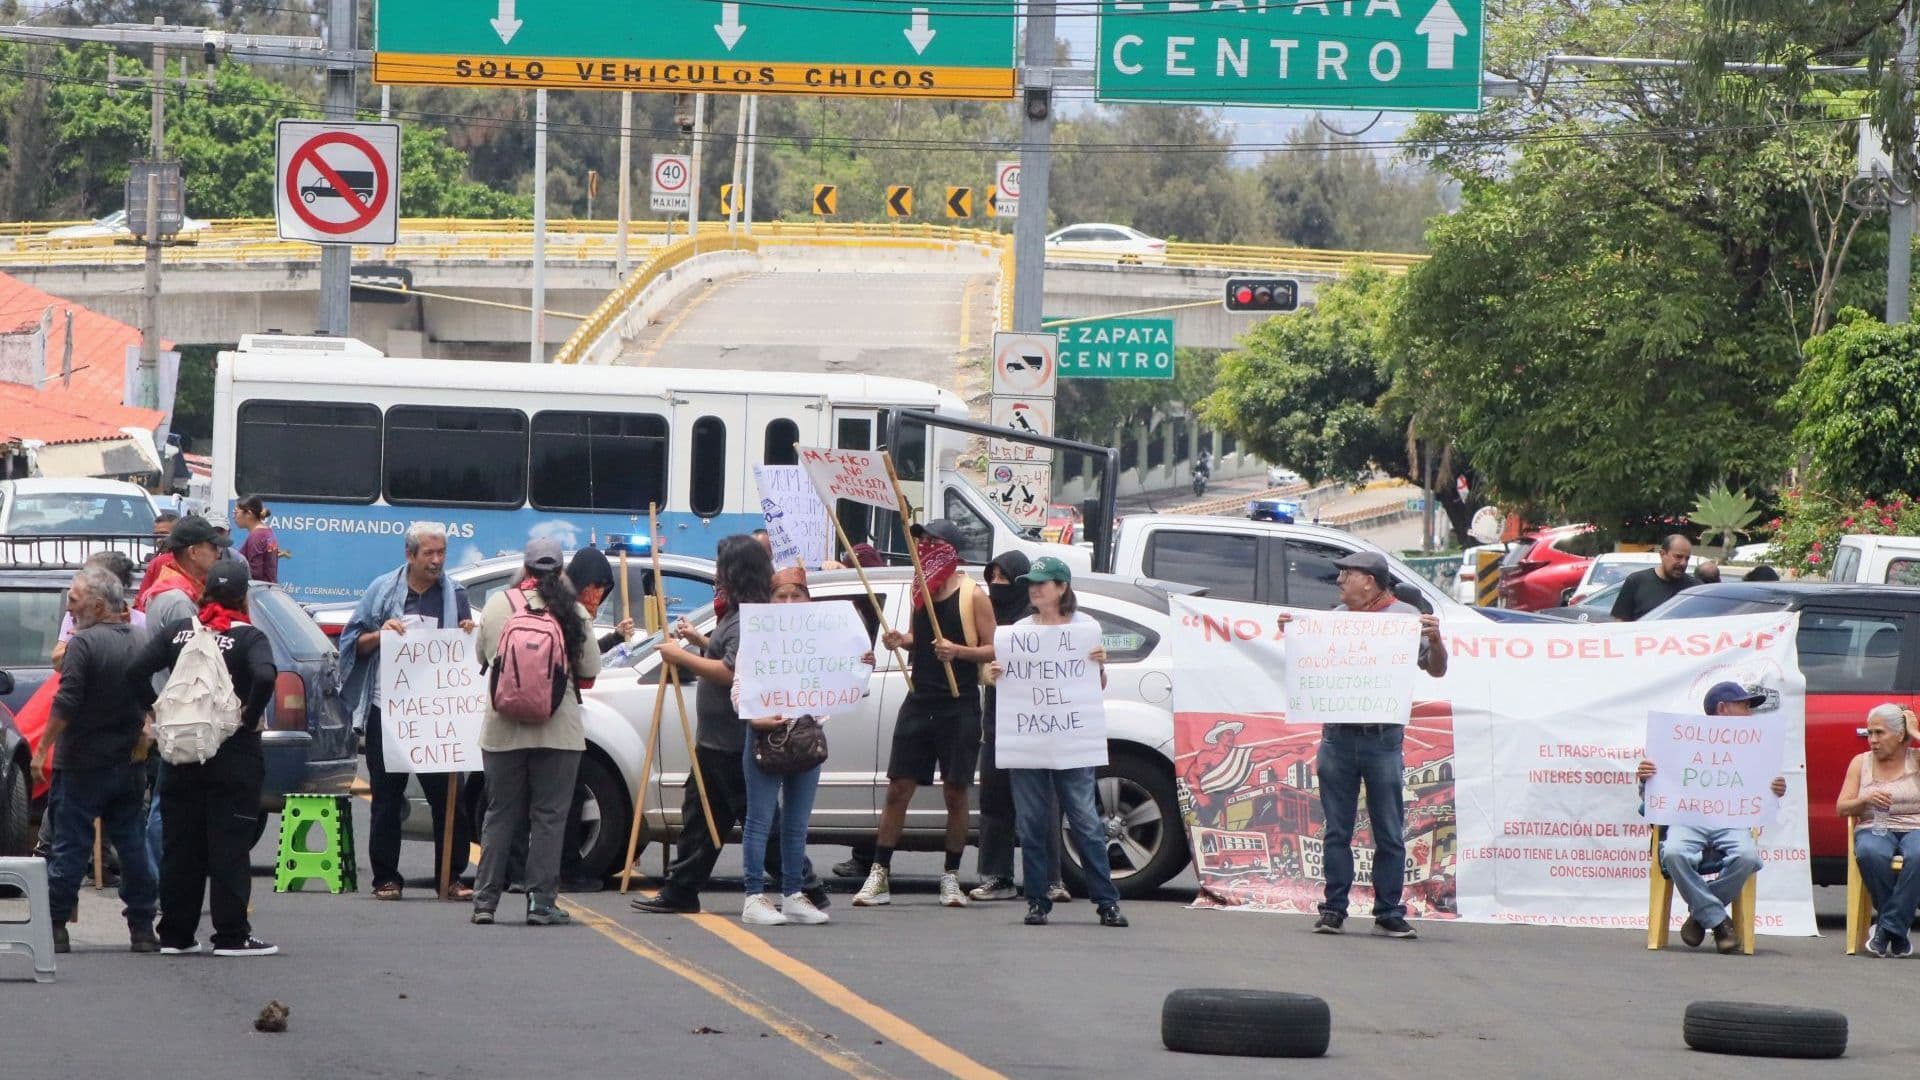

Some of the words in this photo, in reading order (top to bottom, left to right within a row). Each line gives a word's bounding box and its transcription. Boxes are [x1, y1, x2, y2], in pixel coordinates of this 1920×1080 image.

[1113, 35, 1401, 81] CENTRO
[456, 59, 544, 80] SOLO
[575, 62, 775, 85] VEHICULOS
[804, 67, 935, 89] CHICOS
[662, 165, 681, 179] 40
[1058, 327, 1070, 343] E
[1078, 327, 1169, 344] ZAPATA
[1058, 351, 1169, 369] CENTRO
[394, 639, 465, 664] APOYO
[760, 640, 770, 655] A
[781, 638, 817, 655] LOS
[1011, 632, 1040, 654] NO
[1057, 631, 1077, 652] AL
[1547, 637, 1625, 660] DEL
[394, 668, 410, 691] A
[436, 667, 472, 689] LOS
[1005, 659, 1086, 680] AUMENTO
[800, 677, 822, 690] DE
[388, 695, 488, 717] MAESTROS
[760, 687, 860, 708] VELOCIDAD
[1032, 687, 1072, 706] DEL
[398, 720, 420, 740] DE
[434, 720, 457, 739] LA
[1017, 711, 1084, 733] PASAJE
[1672, 724, 1762, 745] SOLUCION
[410, 742, 466, 765] CNTE
[1539, 744, 1554, 758] EL
[1556, 744, 1630, 759] TRASPORTE
[1691, 751, 1704, 765] A
[1711, 751, 1733, 765] LA
[1584, 770, 1633, 785] SOCIAL
[1682, 767, 1744, 788] PODA
[1649, 796, 1668, 809] DE
[1677, 796, 1763, 817] ARBOLES
[1504, 820, 1593, 837] ESTATIZACIÓN
[1595, 824, 1620, 837] DEL
[1479, 847, 1521, 860] ESTADO
[1524, 848, 1553, 860] TIENE
[1555, 848, 1568, 861] LA
[1570, 847, 1637, 862] OBLIGACIÓN
[1785, 849, 1807, 861] LOS
[1550, 865, 1647, 879] CONCESIONARIOS
